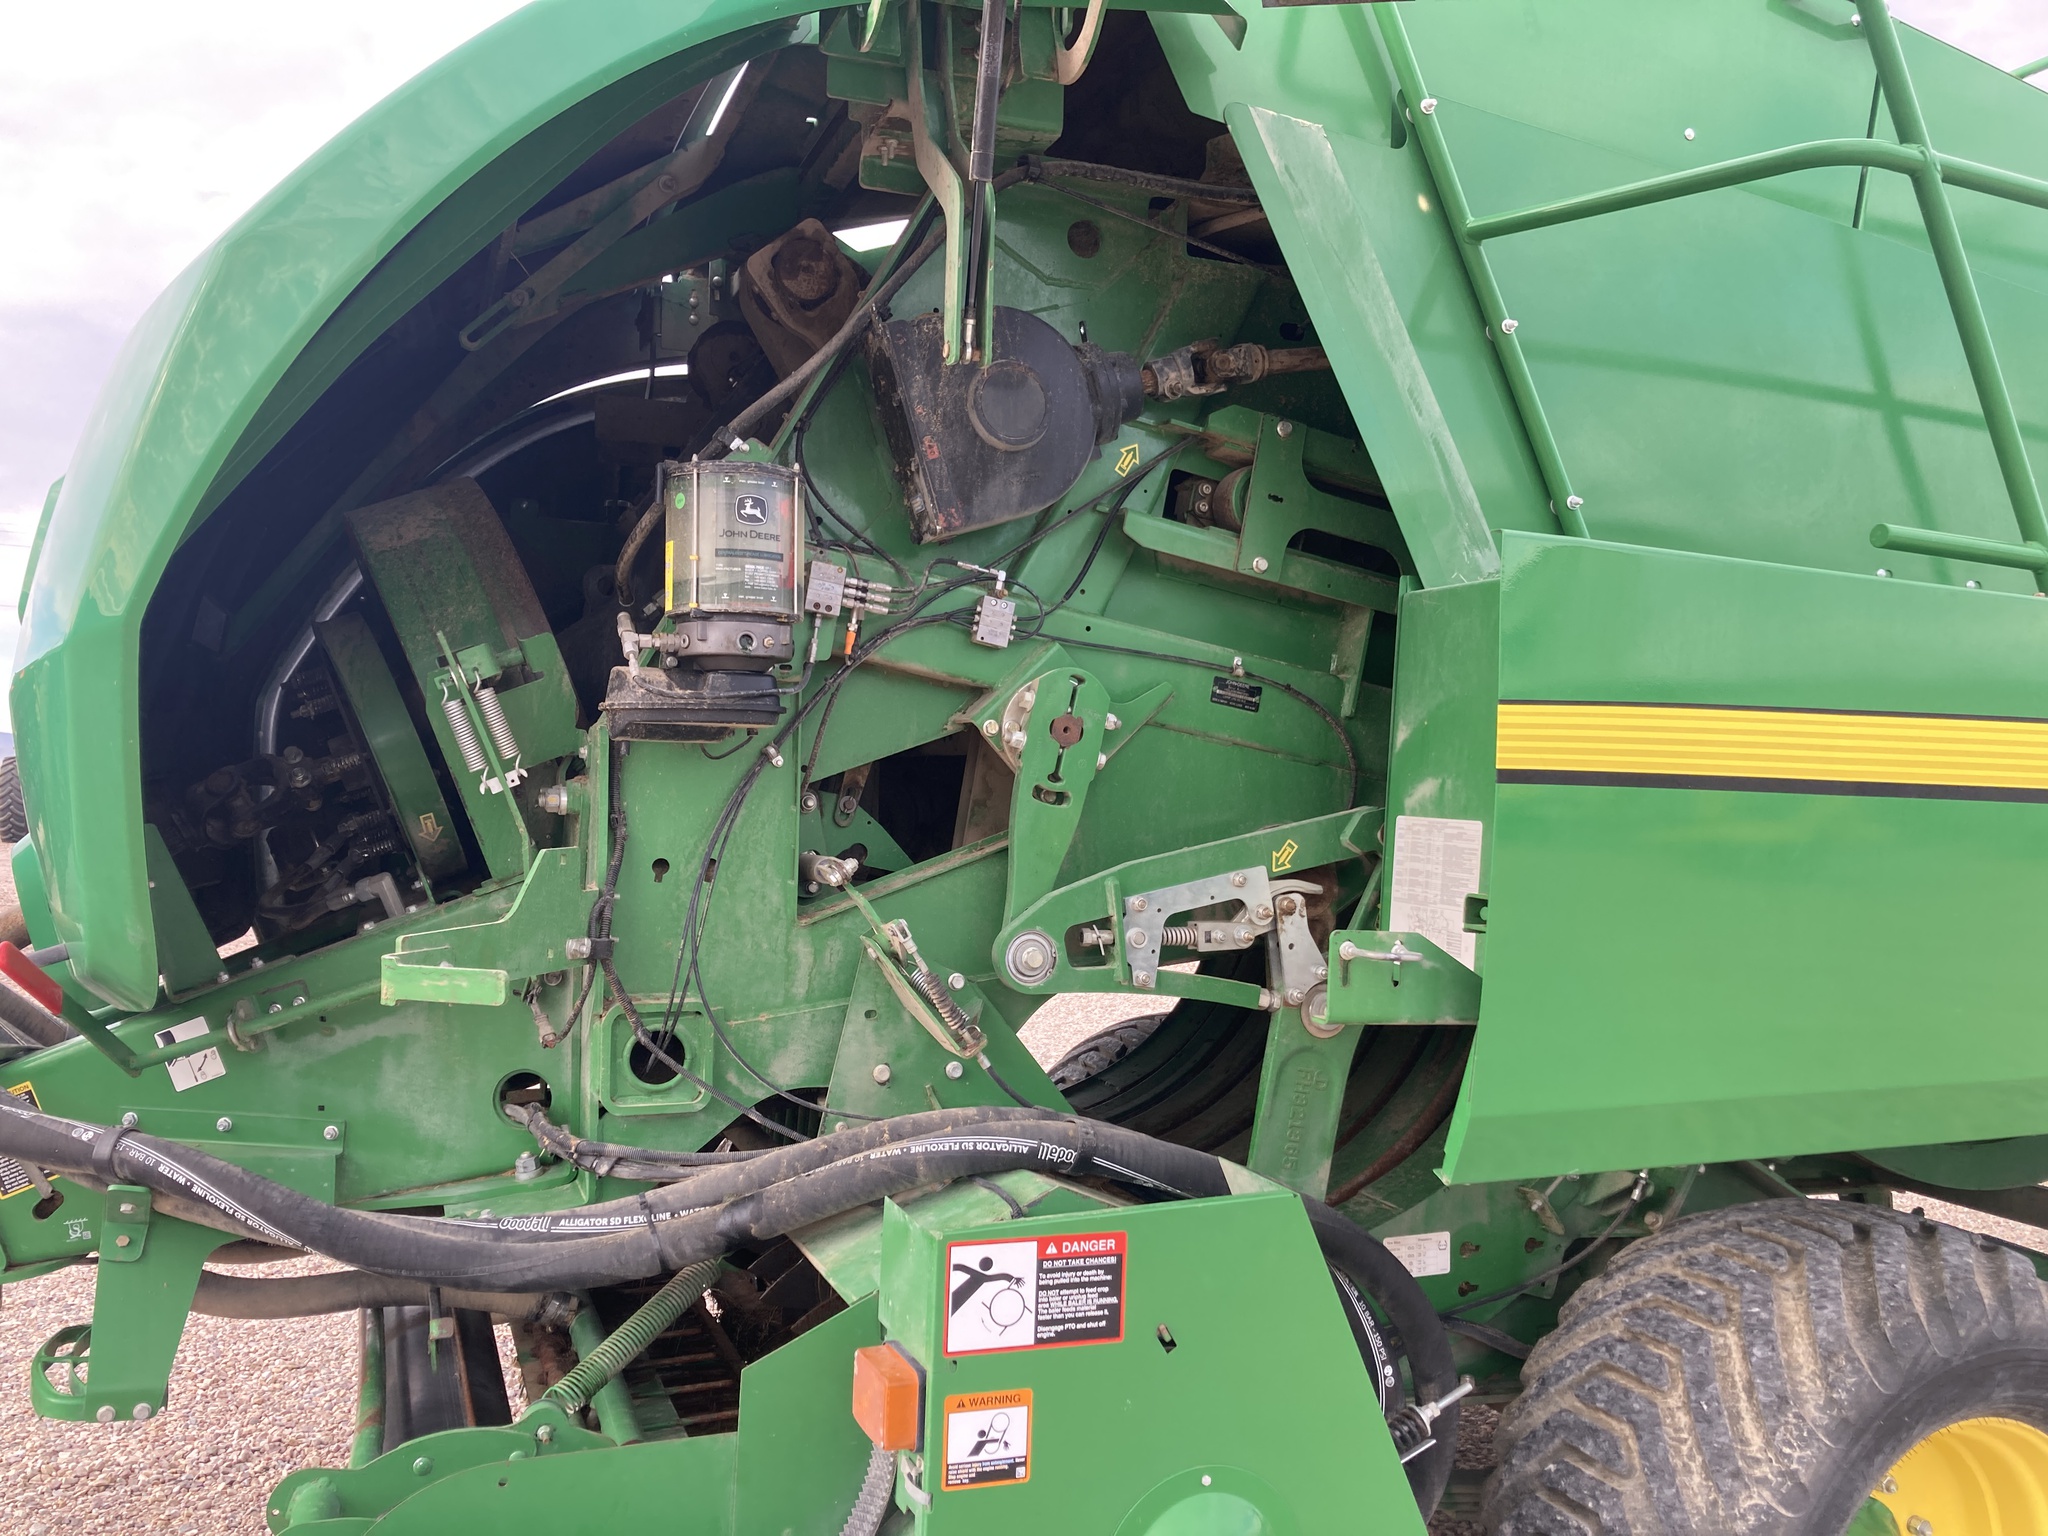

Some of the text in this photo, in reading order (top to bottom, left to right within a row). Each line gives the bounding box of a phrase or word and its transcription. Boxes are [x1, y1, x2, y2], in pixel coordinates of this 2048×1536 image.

[719, 529, 781, 542] JOHN DEERE
[870, 1148, 901, 1159] WATER
[910, 1142, 960, 1154] FLEXOLINE
[976, 1141, 1029, 1154] ALLIGATOR
[129, 1148, 146, 1162] BAR
[145, 1157, 156, 1166] 10
[157, 1163, 186, 1186] WATER
[191, 1183, 234, 1215] FLEXOLINE
[235, 1212, 246, 1222] SD
[559, 1218, 608, 1226] ALLIGATOR
[610, 1217, 620, 1226] SD
[499, 1216, 551, 1232] Goodall
[1062, 1239, 1116, 1254] DANGER
[1043, 1256, 1117, 1268] DO NOT TAKE CHANCES!
[1047, 1271, 1060, 1279] avoid
[1062, 1271, 1075, 1279] injury
[1359, 1300, 1366, 1311] 10
[1364, 1310, 1375, 1328] BAR
[1373, 1332, 1383, 1347] 150
[1379, 1344, 1387, 1361] PSI
[969, 1394, 1021, 1407] WARNING
